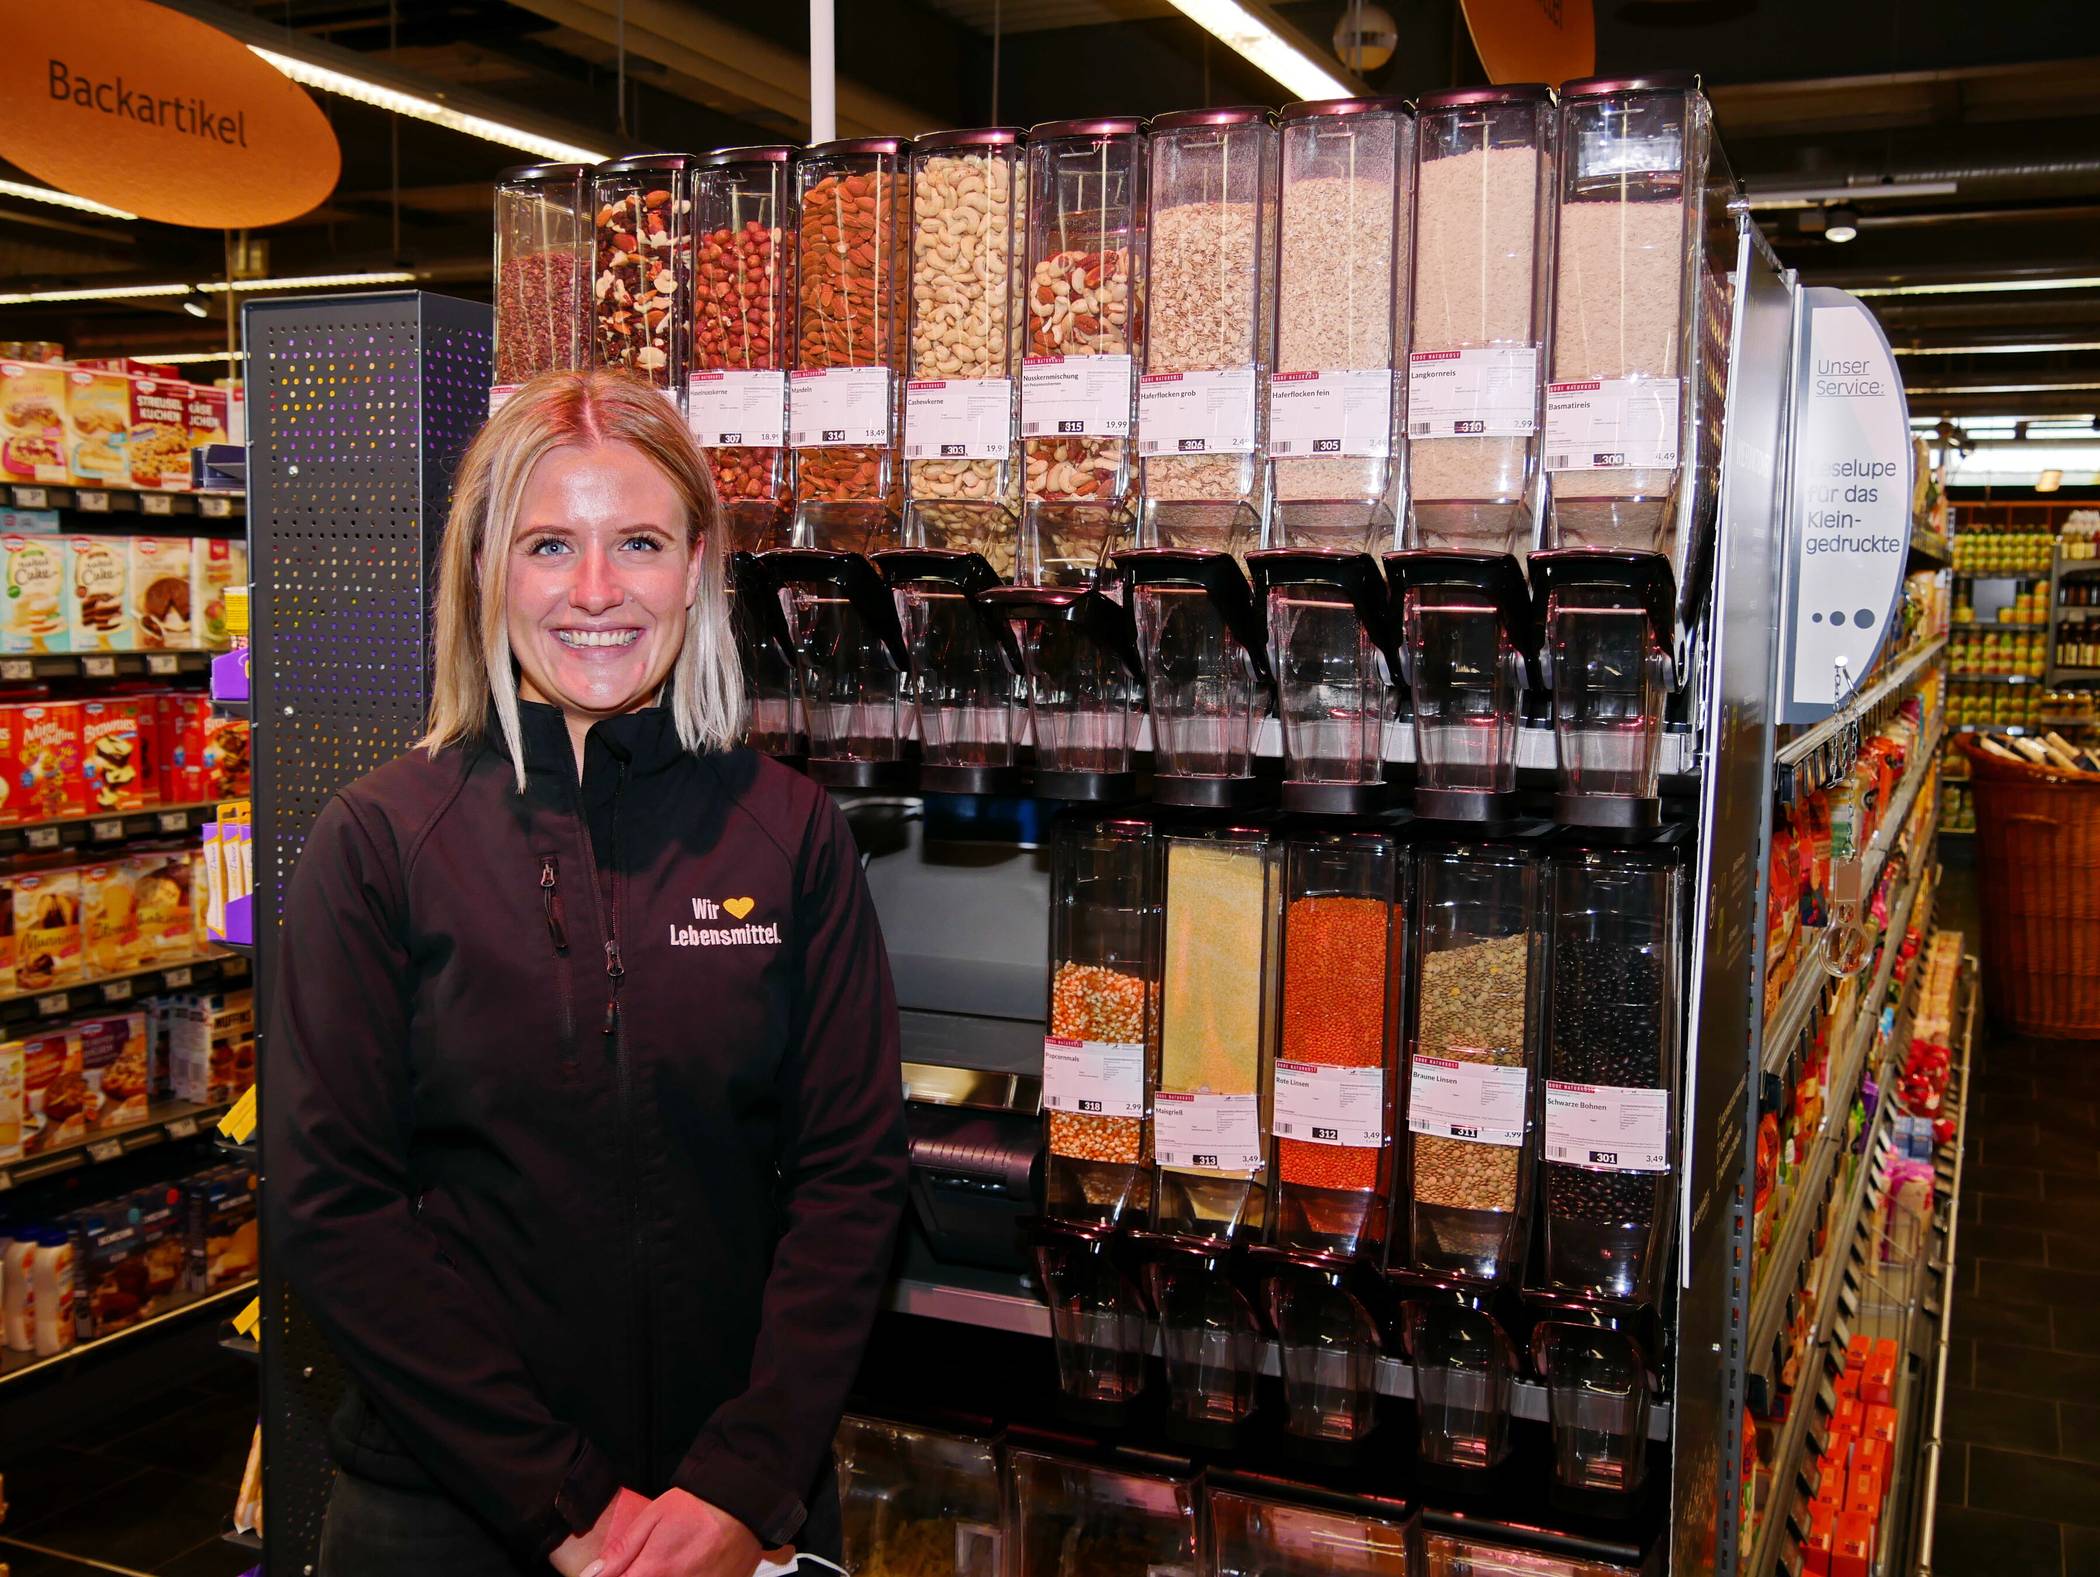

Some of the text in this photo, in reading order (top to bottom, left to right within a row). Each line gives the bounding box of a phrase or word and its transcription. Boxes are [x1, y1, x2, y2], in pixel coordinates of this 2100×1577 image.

[48, 59, 247, 147] Backartikel
[1818, 359, 1870, 375] Unser
[1023, 373, 1079, 381] Nusskernmischung
[1411, 370, 1456, 379] Langkornreis
[1816, 380, 1885, 396] Service:
[1140, 390, 1196, 400] Haferflocken grob
[1272, 389, 1330, 399] Haferflocken fein
[1548, 402, 1590, 411] Basmatireis
[725, 434, 741, 443] 307
[827, 431, 844, 440] 314
[1185, 440, 1203, 449] 306
[1320, 441, 1338, 450] 305
[1601, 455, 1622, 464] 300
[1844, 485, 1878, 503] das
[1807, 511, 1861, 528] Klein-
[1806, 535, 1900, 554] gedruckte
[692, 898, 720, 919] Wir
[670, 922, 782, 946] Lebensmittel.
[1276, 1077, 1309, 1088] Rote Linsen
[1413, 1071, 1457, 1085] Braune Linsen
[1084, 1102, 1101, 1110] 318
[1126, 1103, 1141, 1111] 2,99
[1547, 1098, 1607, 1111] Schwarze Bohnen
[1319, 1129, 1336, 1139] 312
[1363, 1131, 1380, 1139] 3,49
[1199, 1156, 1216, 1165] 313
[1242, 1154, 1259, 1163] 3,49
[1596, 1153, 1616, 1163] 301
[1645, 1155, 1663, 1163] 3,49
